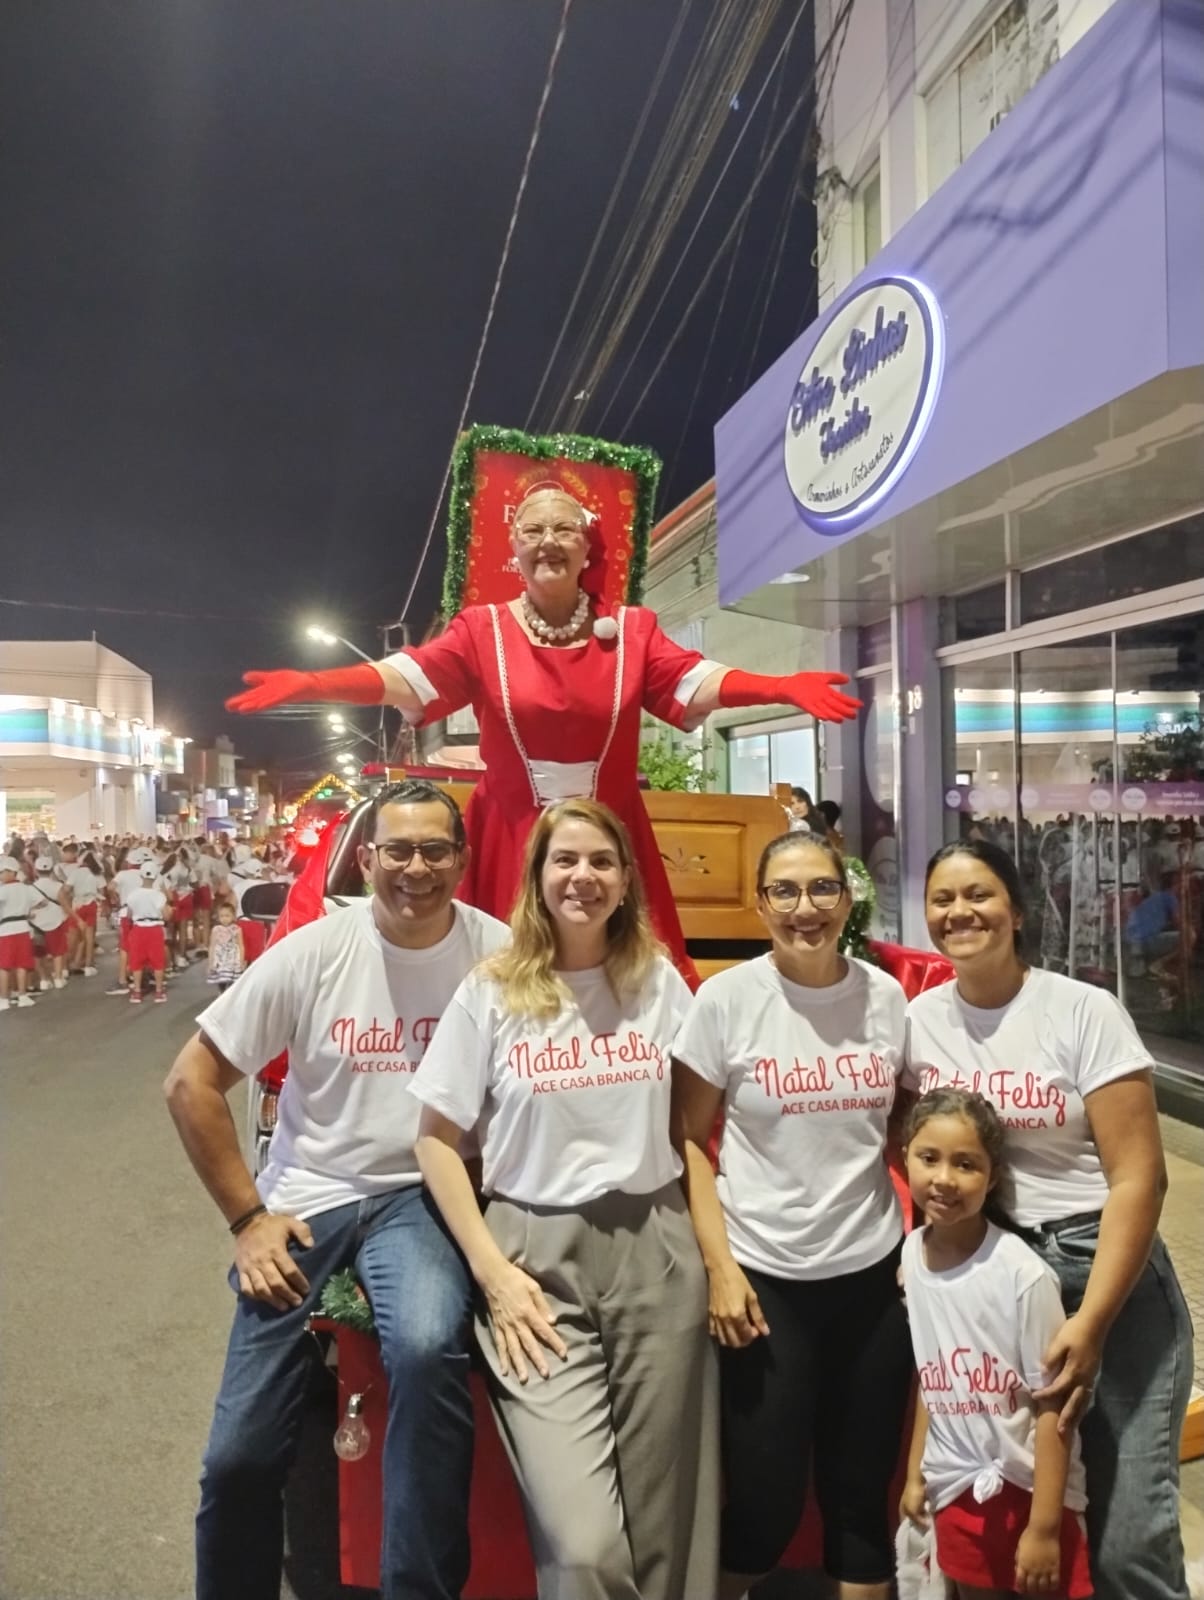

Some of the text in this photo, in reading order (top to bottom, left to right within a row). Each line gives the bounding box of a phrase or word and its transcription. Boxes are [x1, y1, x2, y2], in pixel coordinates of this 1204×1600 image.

[331, 1017, 406, 1057] Natal
[508, 1031, 665, 1081] Natal Feliz
[352, 1061, 374, 1073] ACE
[376, 1061, 407, 1073] CASA
[533, 1069, 650, 1095] ACE CASA BRANCA
[755, 1056, 833, 1099] Natal
[781, 1102, 806, 1116] ACE
[808, 1100, 840, 1113] CASA
[989, 1070, 1066, 1127] Feliz
[951, 1347, 1023, 1412] Feliz
